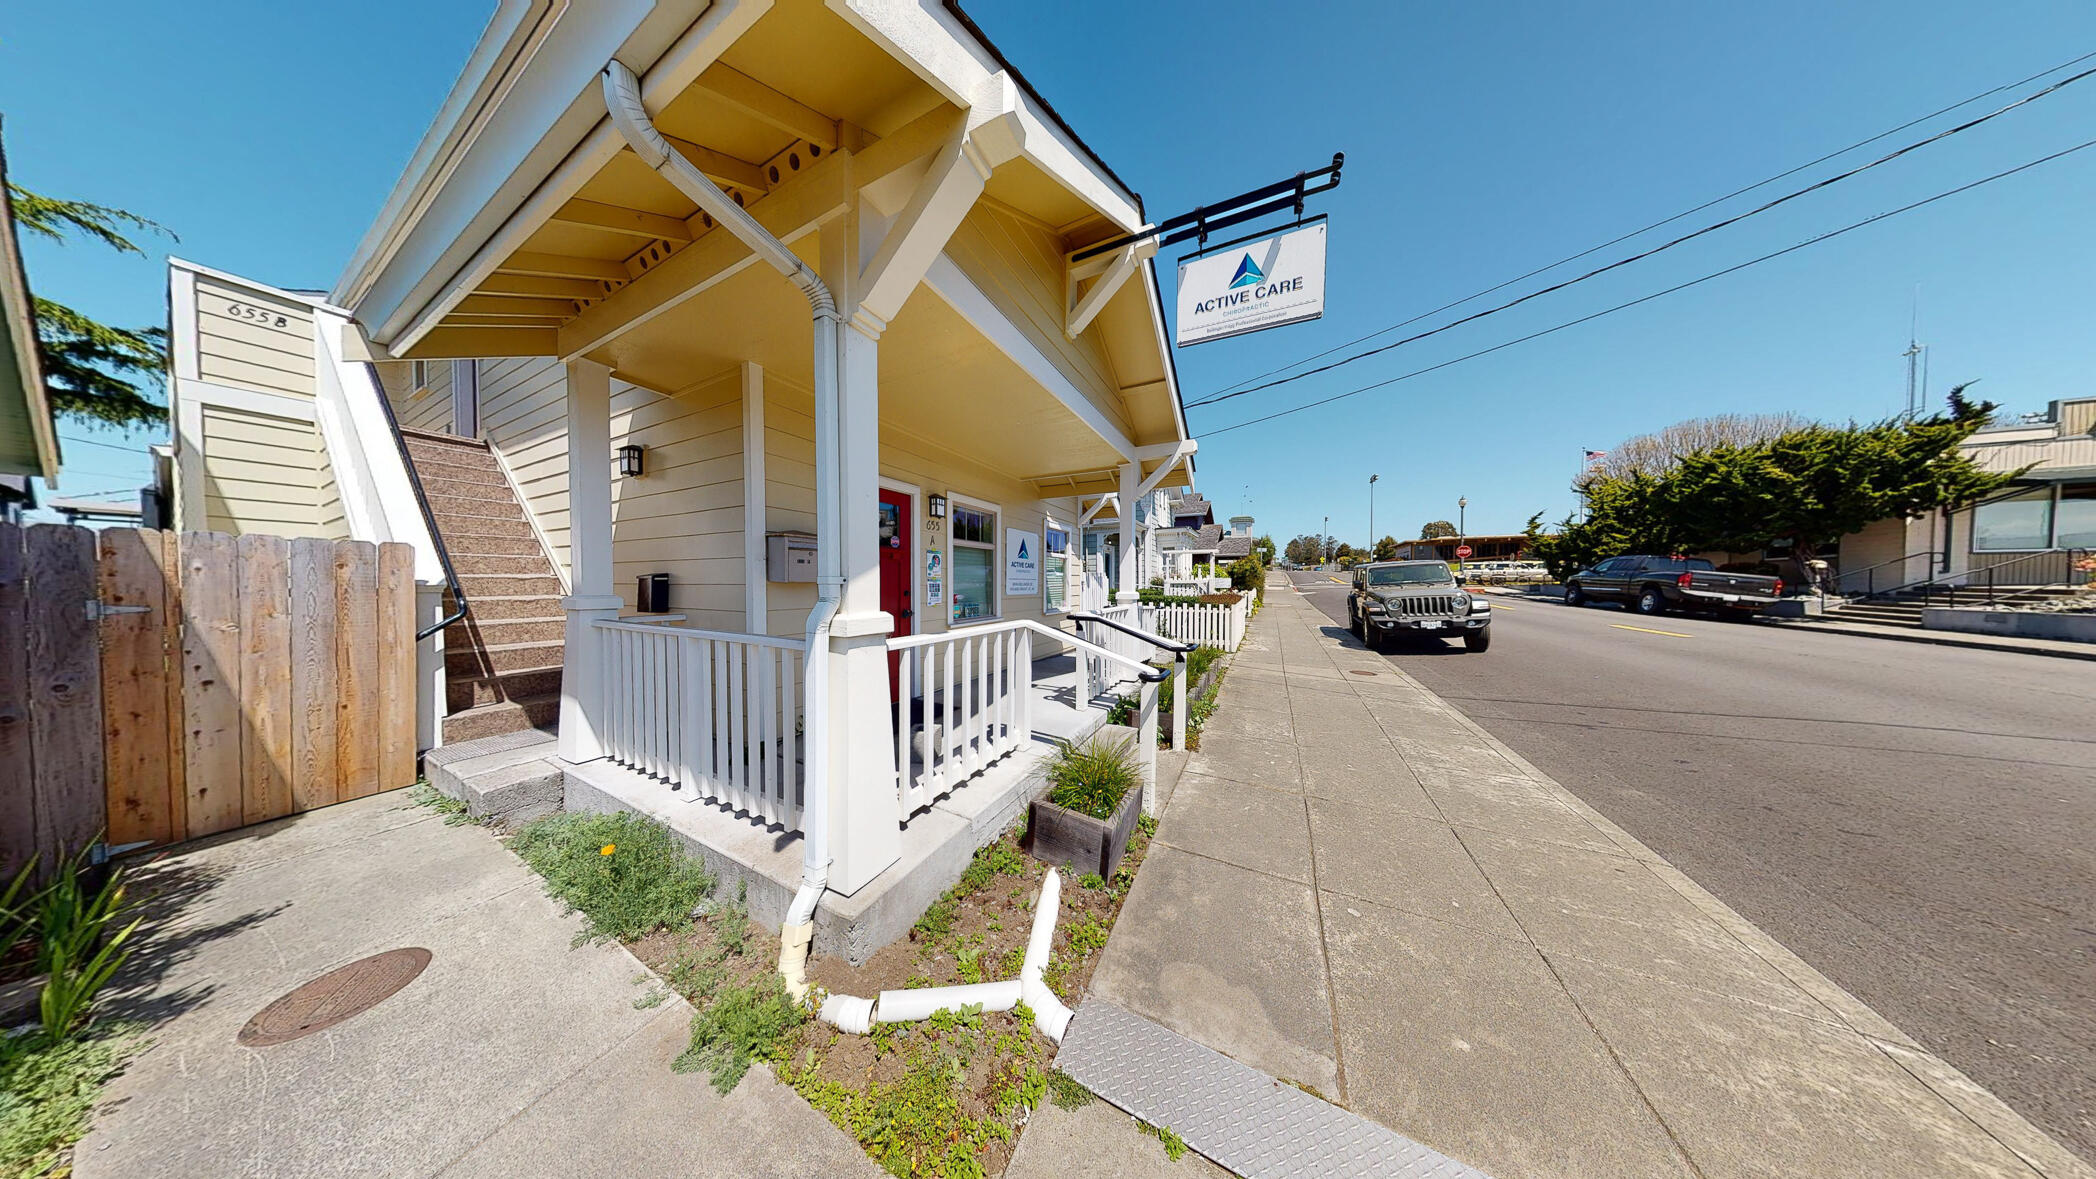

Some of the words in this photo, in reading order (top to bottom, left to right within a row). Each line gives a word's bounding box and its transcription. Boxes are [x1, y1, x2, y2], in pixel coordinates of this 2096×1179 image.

[1194, 289, 1250, 315] ACTIVE
[1254, 276, 1303, 300] CARE
[1222, 301, 1270, 318] CHIROPRACTIC
[926, 520, 940, 531] 655
